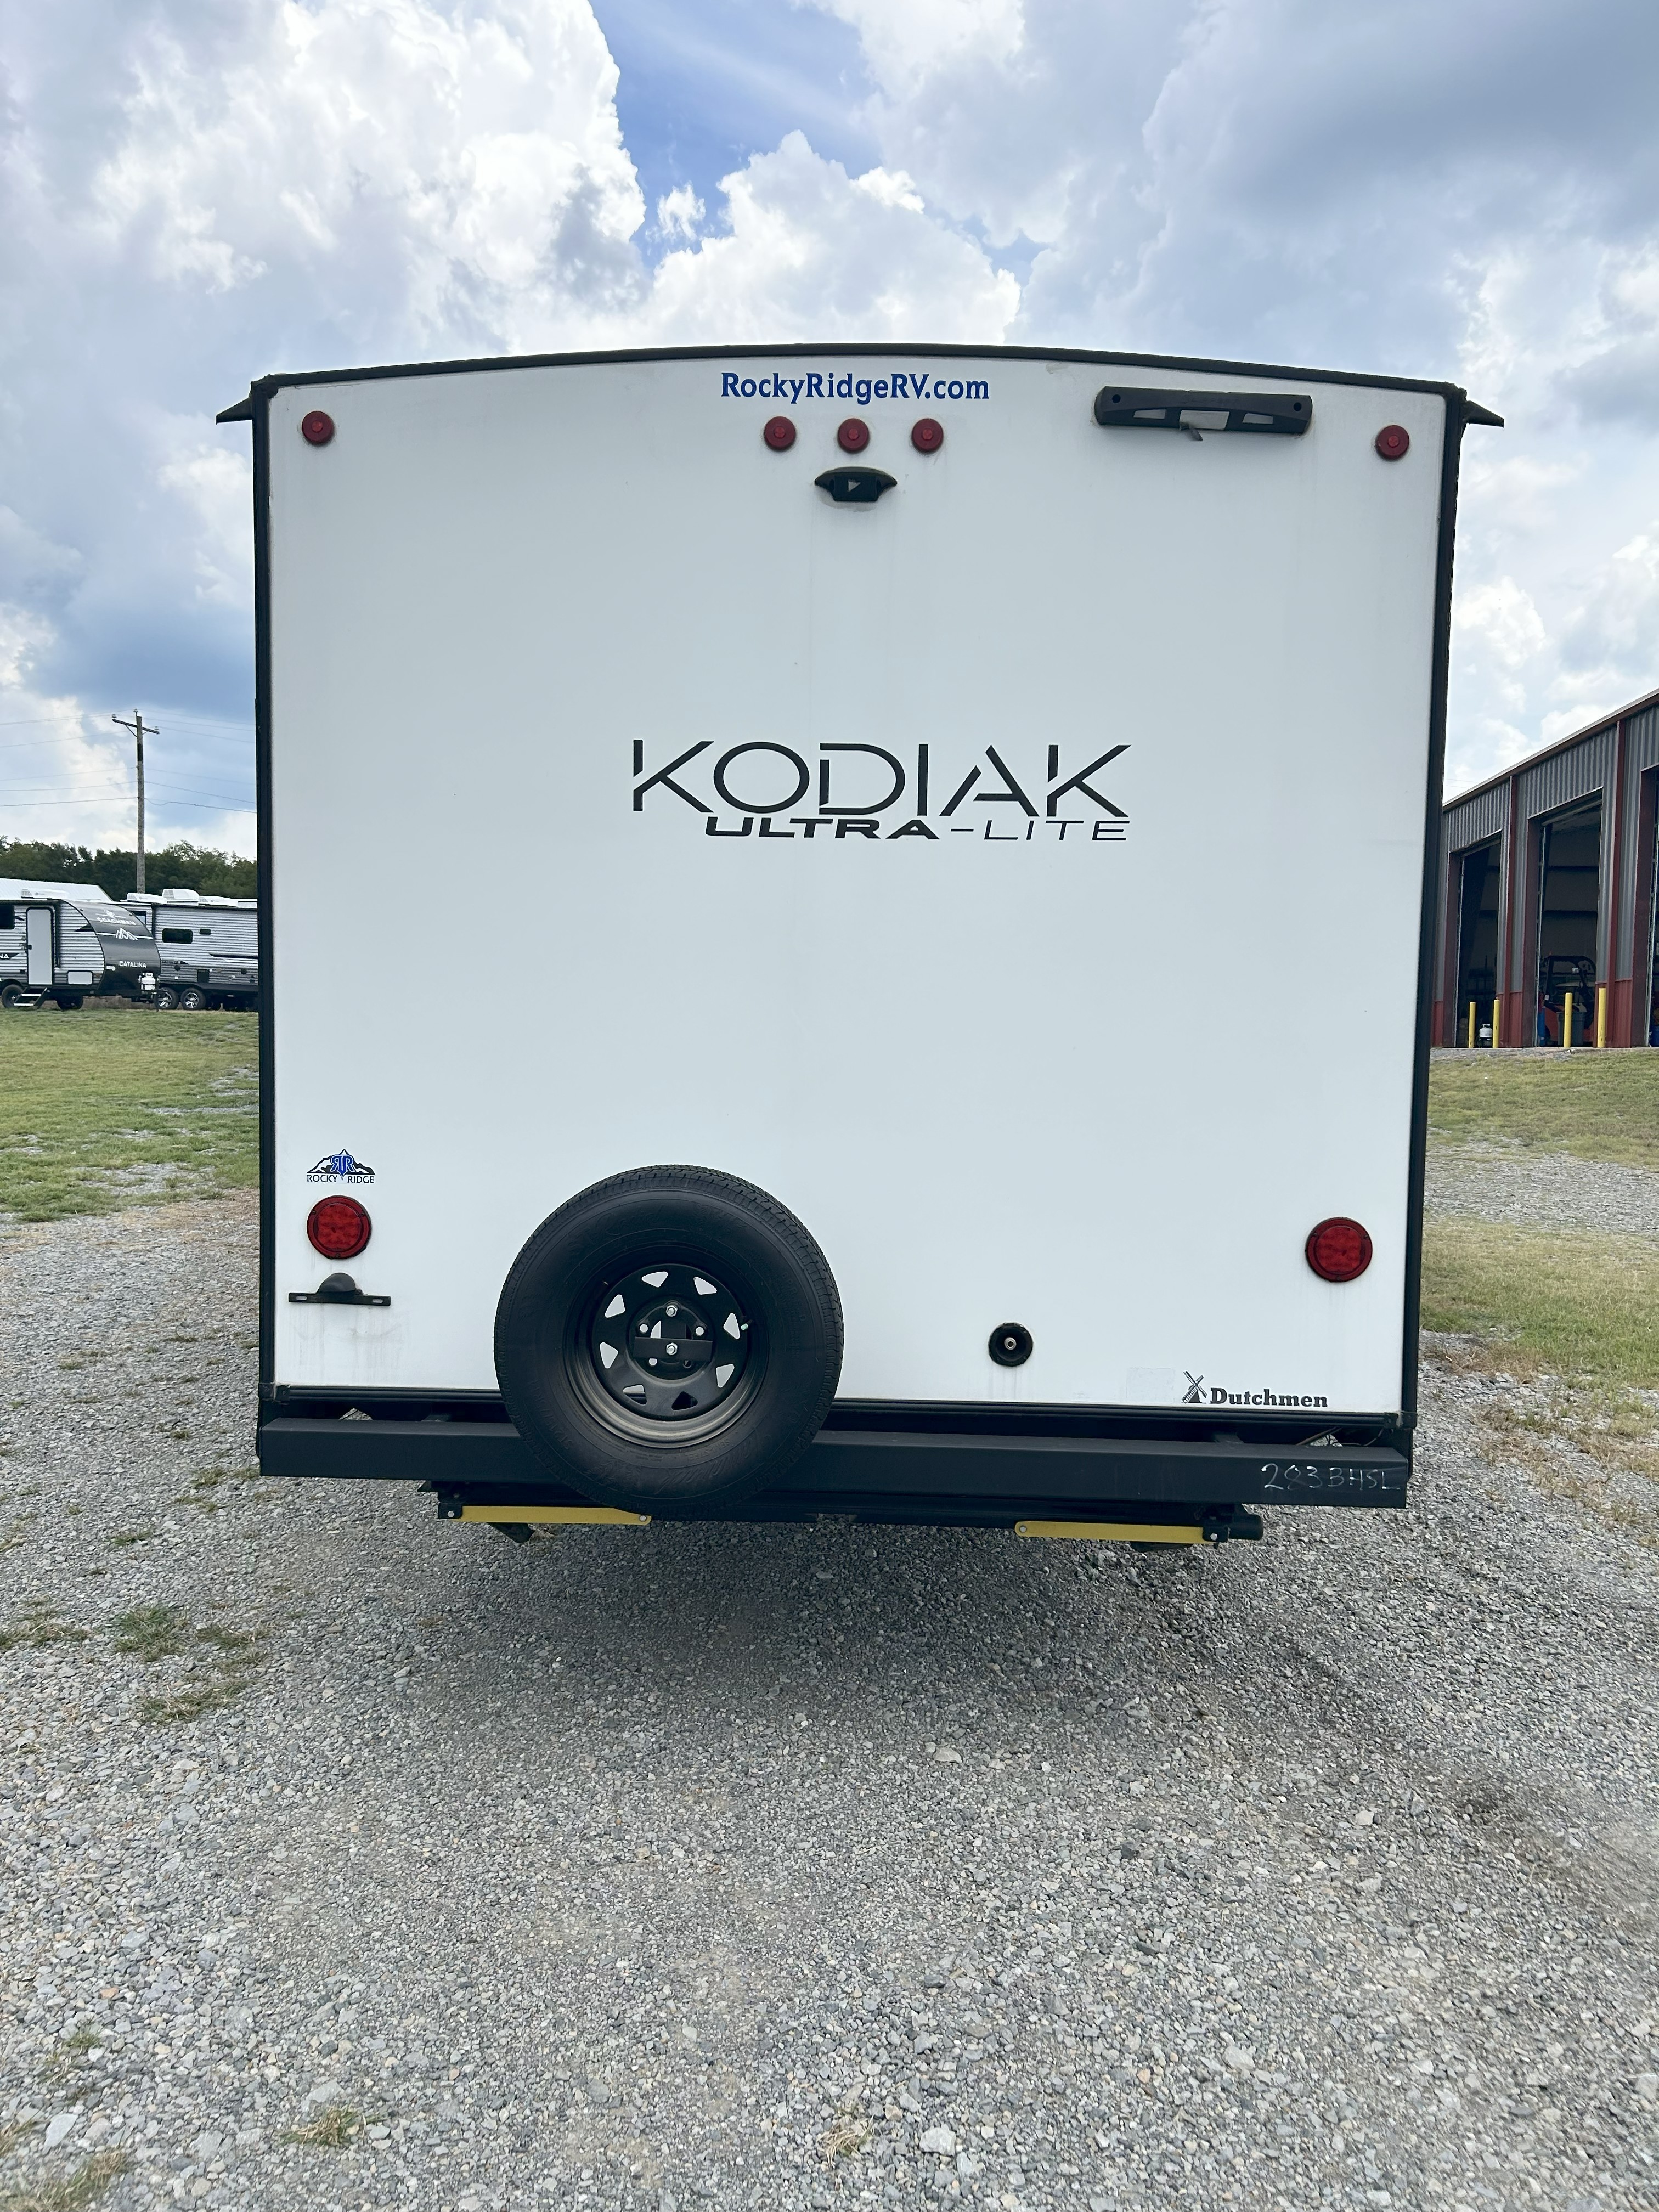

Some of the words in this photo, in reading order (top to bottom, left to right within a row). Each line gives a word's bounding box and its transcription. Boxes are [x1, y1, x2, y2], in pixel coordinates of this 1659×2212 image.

[721, 372, 990, 405] RockyRidgeRV.com
[633, 740, 1132, 817] KODIAK
[705, 816, 1131, 841] ULTRA-LITE
[97, 917, 136, 926] COACHMEN
[307, 1174, 337, 1182] ROCKY
[347, 1175, 374, 1183] RIDGE
[1210, 1387, 1328, 1408] Dutchmen
